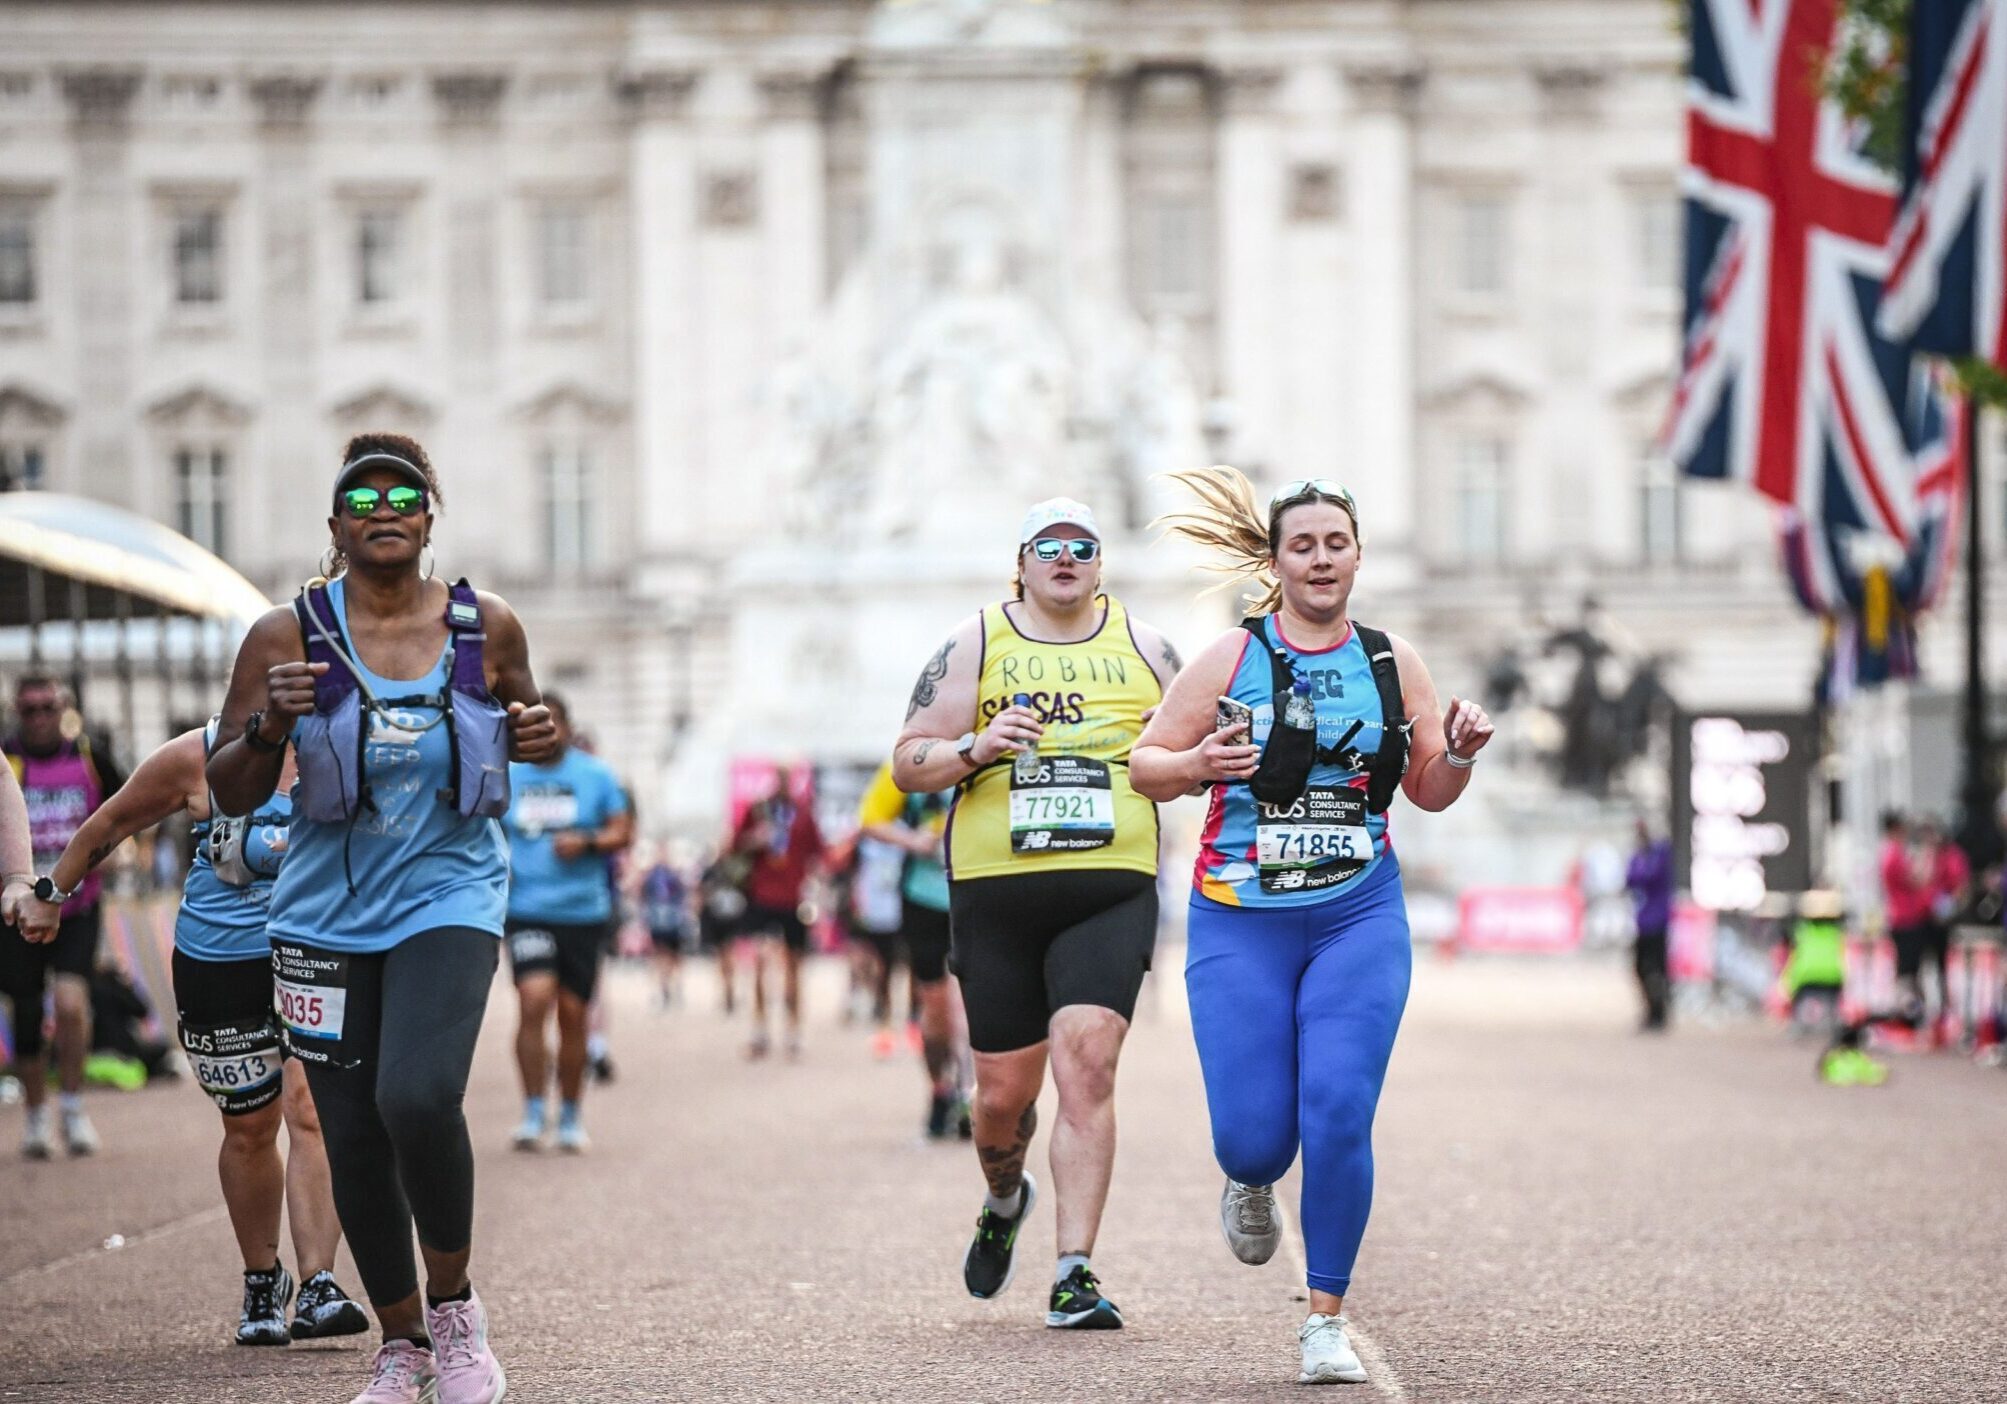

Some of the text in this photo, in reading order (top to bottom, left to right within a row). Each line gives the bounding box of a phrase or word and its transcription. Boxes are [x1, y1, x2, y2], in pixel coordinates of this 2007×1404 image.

[1002, 655, 1126, 687] ROBIN
[1302, 669, 1344, 700] EG
[1316, 716, 1343, 727] dical
[1054, 760, 1077, 768] TATA
[1054, 767, 1105, 777] CONSULTANCY
[1054, 775, 1089, 784] SERVICES
[1309, 791, 1335, 800] TATA
[1026, 795, 1094, 819] 77921
[1309, 801, 1361, 811] CONSULTANCY
[1310, 810, 1346, 819] SERVICES
[1051, 840, 1068, 849] new
[1276, 834, 1355, 860] 71855
[1307, 877, 1326, 887] new
[281, 946, 304, 958] TATA
[282, 956, 339, 971] CONSULTANCY
[282, 966, 316, 979] SERVICES
[214, 1027, 237, 1037] TATA
[215, 1029, 269, 1044] CONSULTANCY
[216, 1041, 251, 1052] SERVICES
[198, 1055, 267, 1086] 64613
